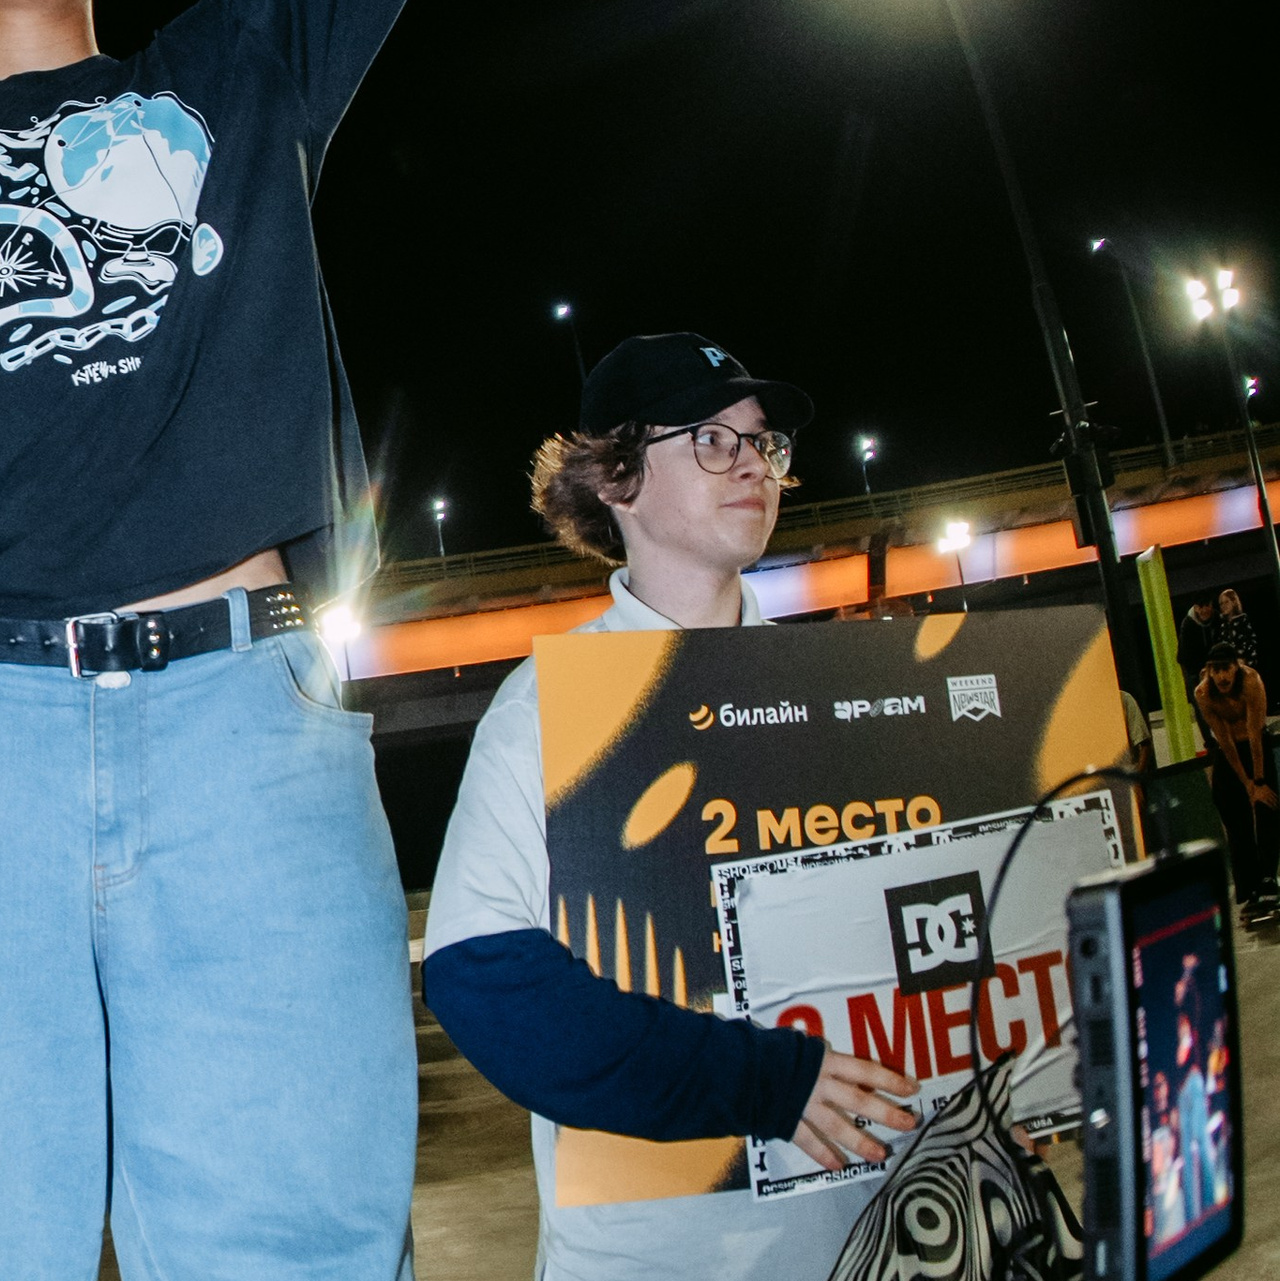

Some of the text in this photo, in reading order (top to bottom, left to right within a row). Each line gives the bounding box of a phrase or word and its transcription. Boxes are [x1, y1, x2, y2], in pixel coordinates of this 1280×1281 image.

[720, 701, 808, 727] билайн
[701, 795, 942, 854] 2 место
[847, 950, 1074, 1082] МЕСТ
